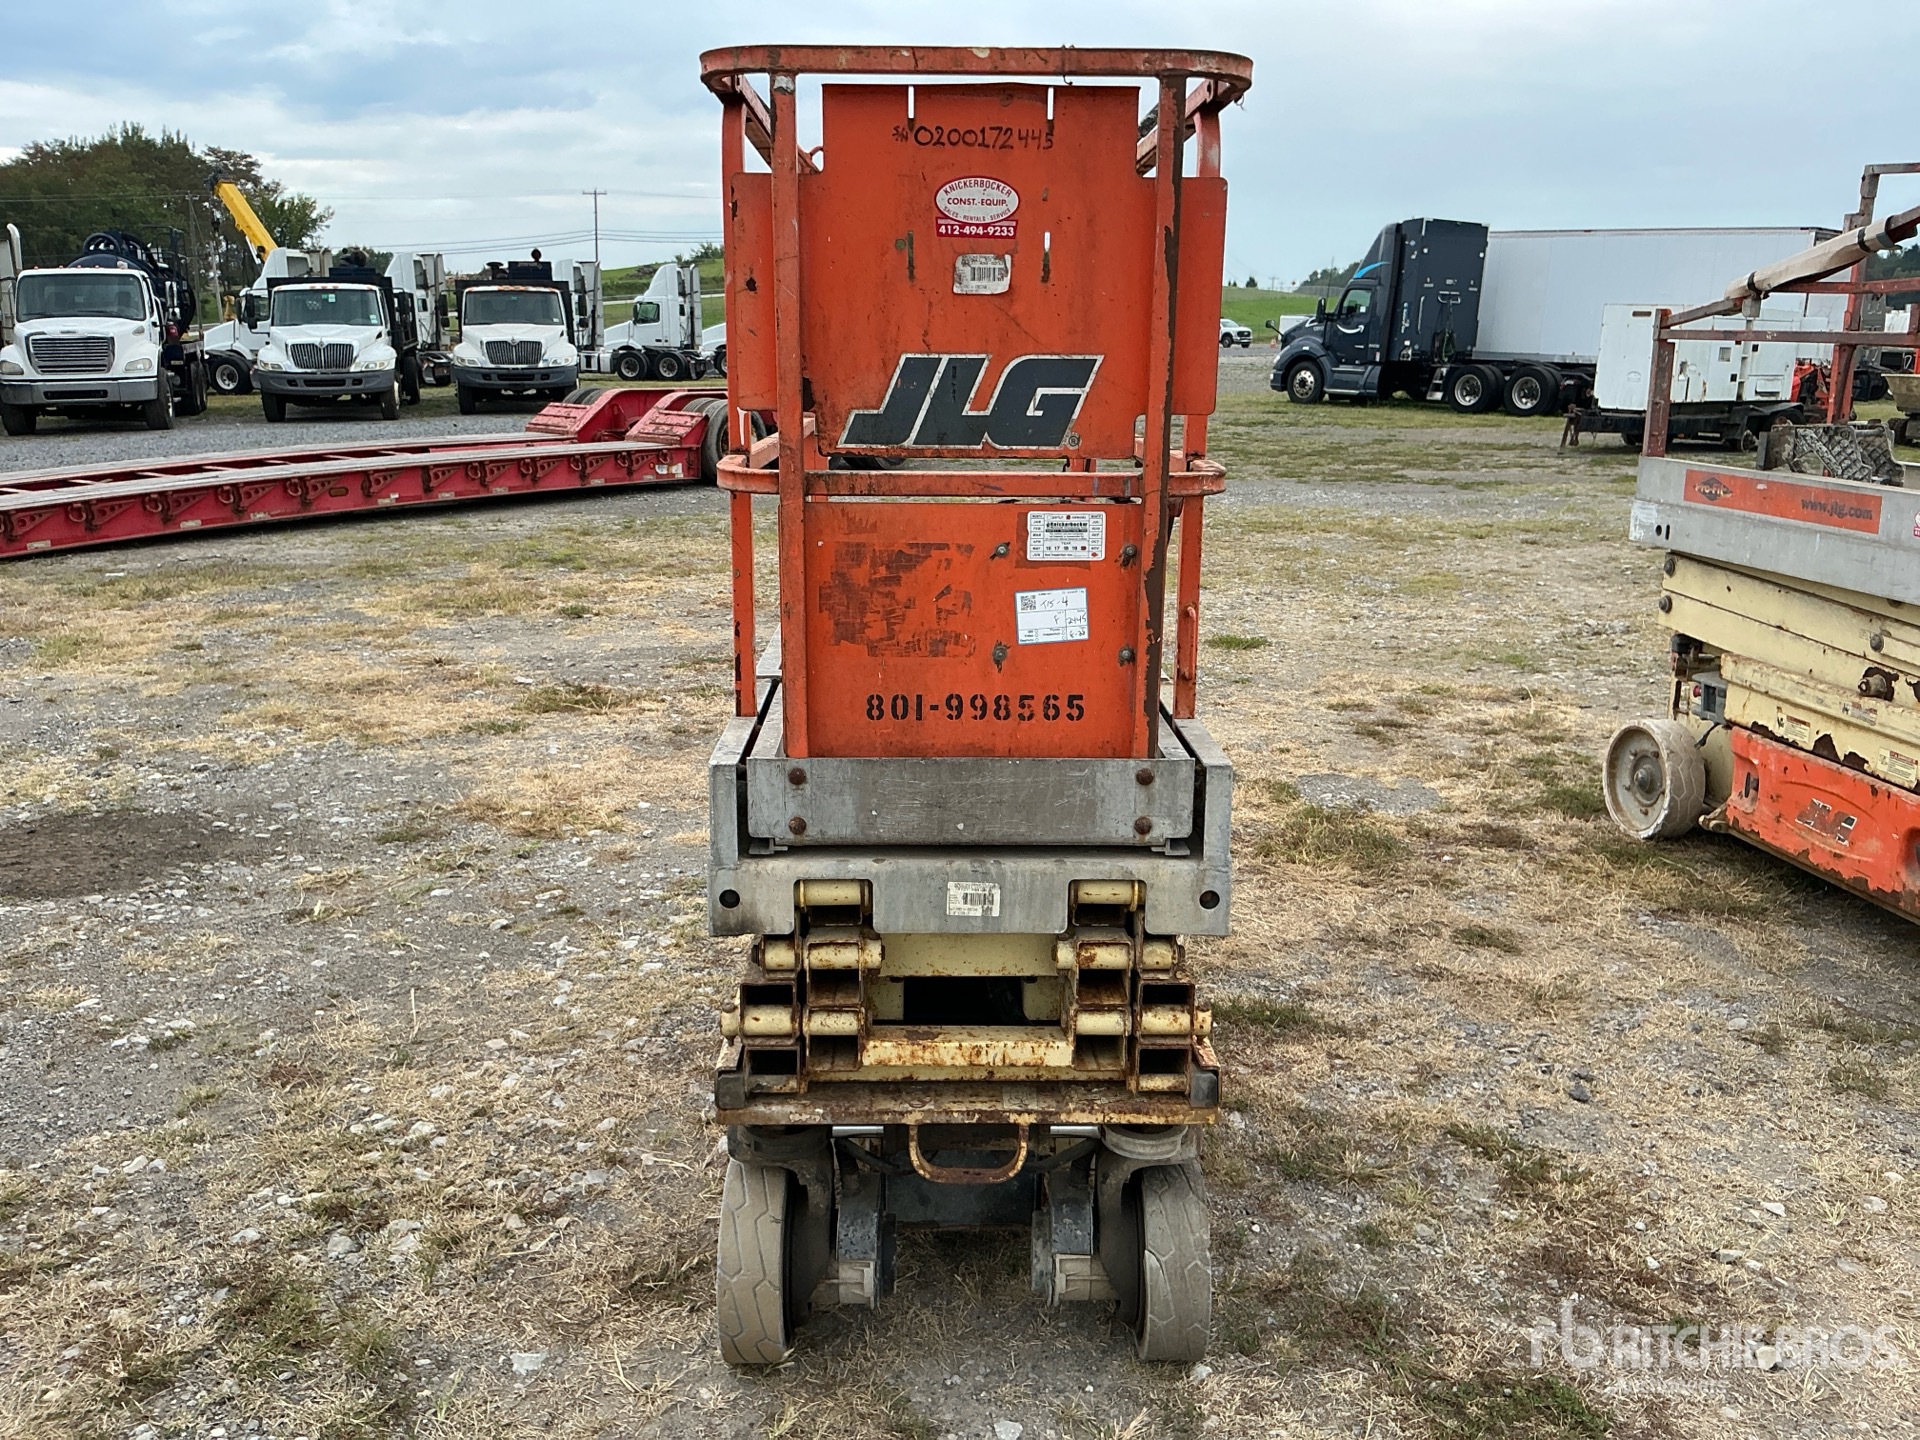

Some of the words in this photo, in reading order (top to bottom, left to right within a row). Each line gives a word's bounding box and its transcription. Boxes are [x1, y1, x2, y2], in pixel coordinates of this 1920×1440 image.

[914, 125, 1054, 150] 0200172445
[943, 179, 1012, 198] KNICKERBOCKER
[944, 206, 959, 218] SALES
[963, 214, 986, 222] RENTALS
[990, 208, 1011, 220] SERVICE
[939, 225, 1014, 236] 412-494-9233
[836, 354, 1104, 450] JLG
[1801, 499, 1873, 520] www.jlg.com
[866, 693, 1085, 721] 801-998565
